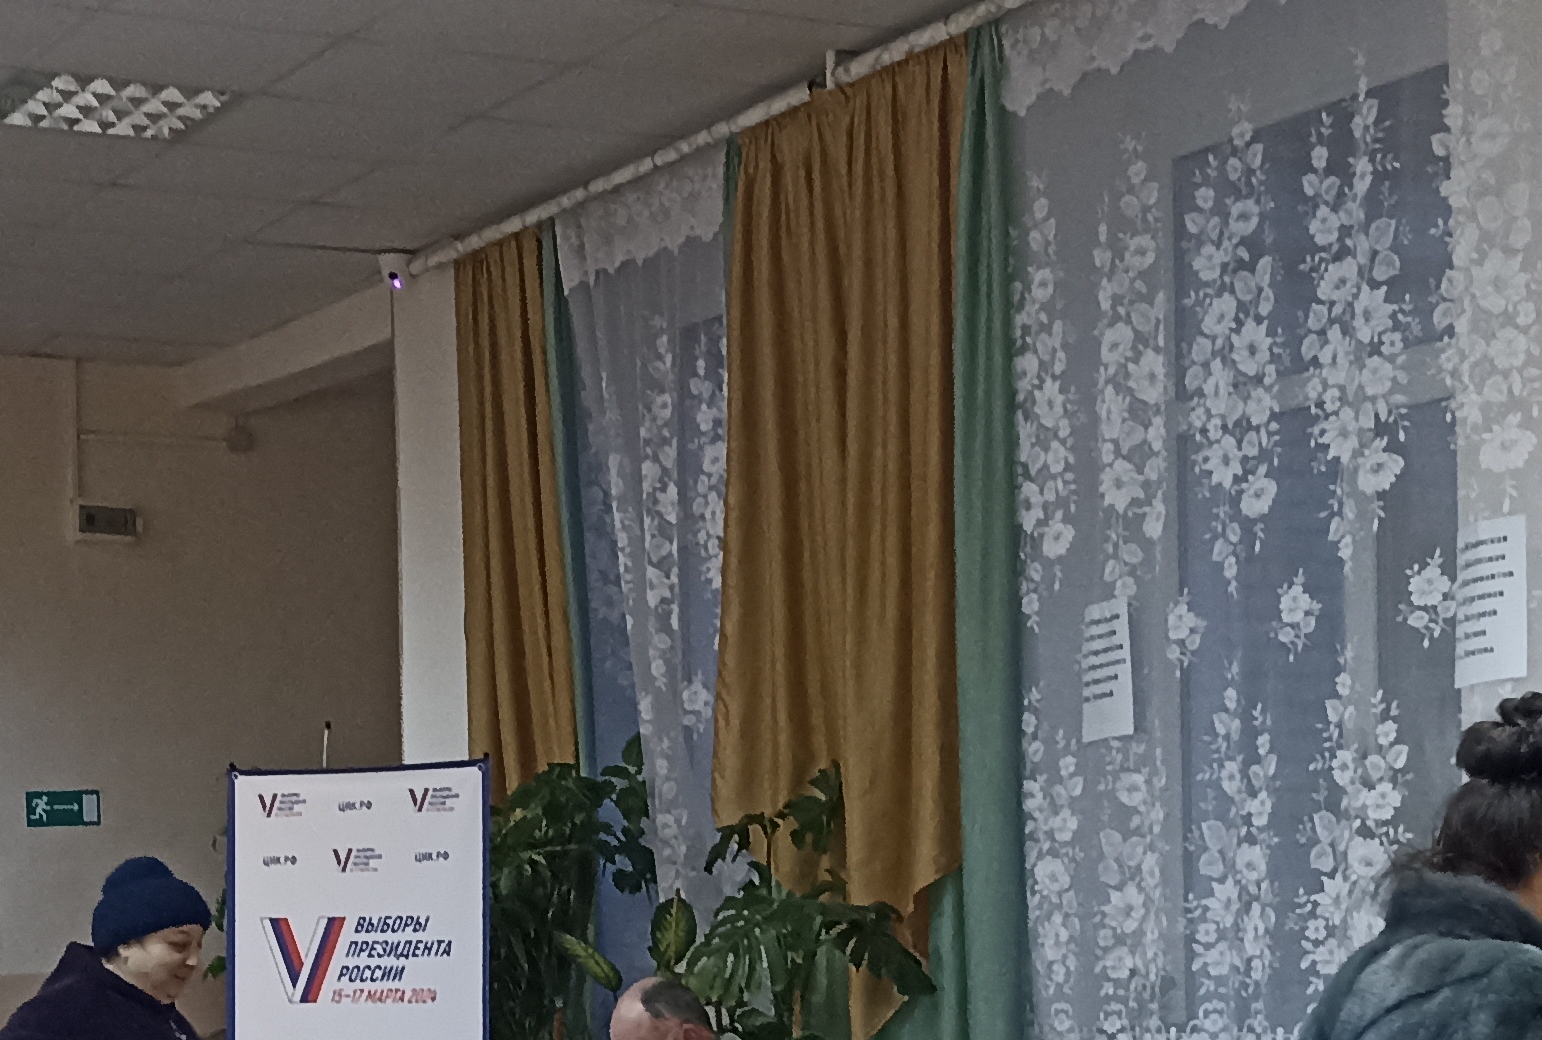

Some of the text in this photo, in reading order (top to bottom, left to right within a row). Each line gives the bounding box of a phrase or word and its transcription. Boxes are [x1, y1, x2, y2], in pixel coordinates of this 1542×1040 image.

[354, 915, 430, 933] ВЫБОРЫ
[345, 939, 453, 960] ПРЕЗИДЕНТА
[337, 964, 406, 982] РОССИИ
